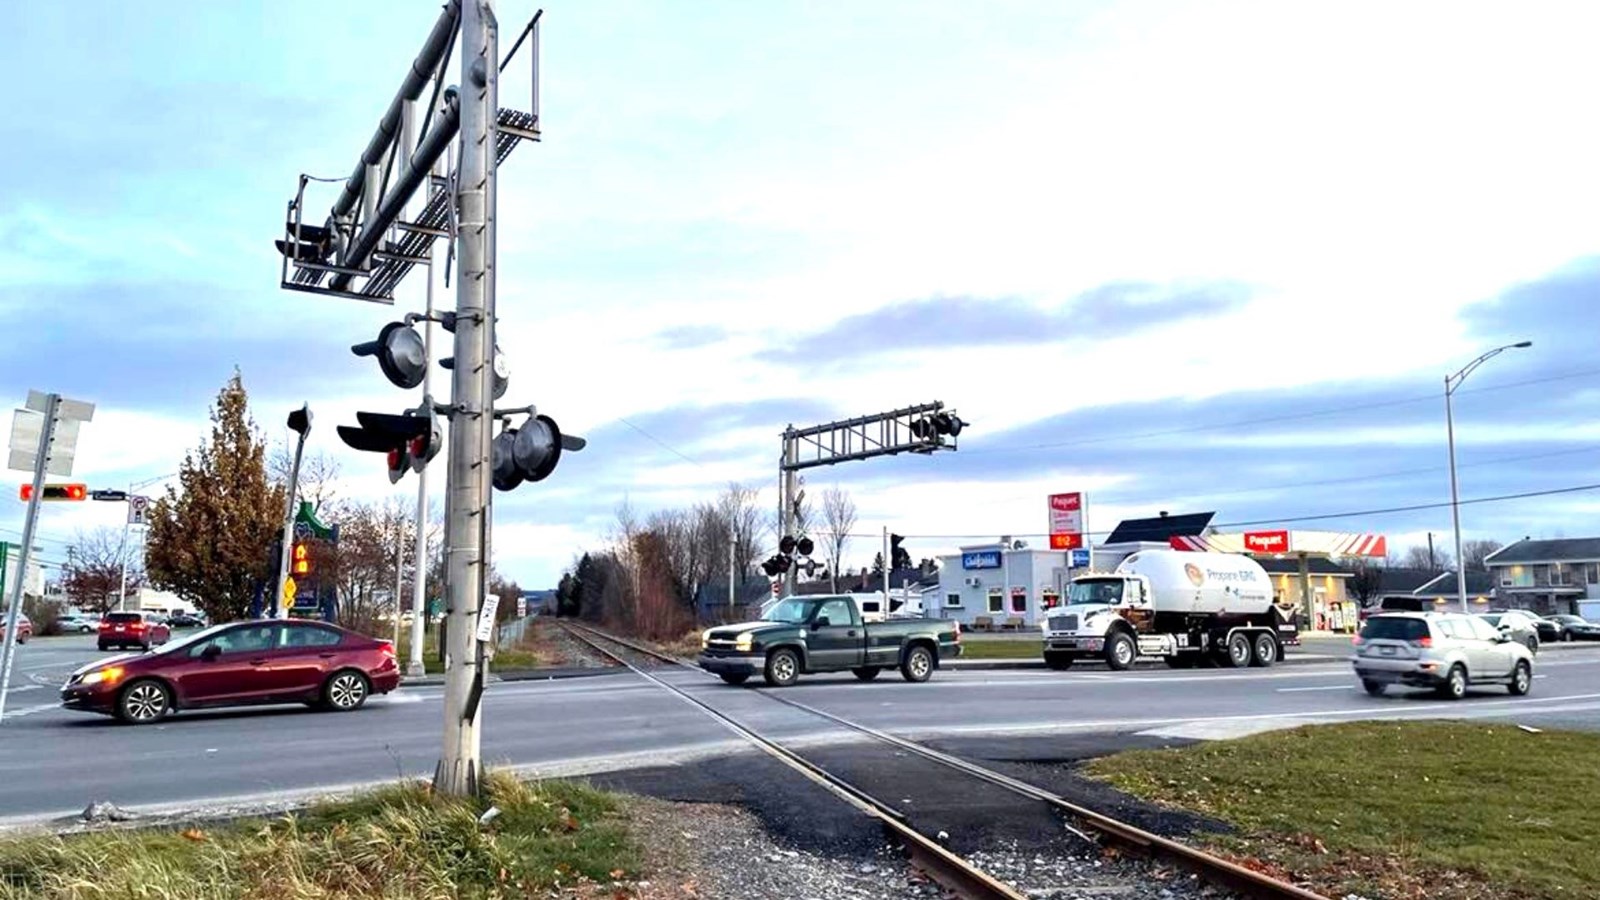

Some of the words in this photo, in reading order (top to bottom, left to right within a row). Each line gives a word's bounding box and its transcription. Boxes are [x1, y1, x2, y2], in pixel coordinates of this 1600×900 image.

[1053, 496, 1078, 508] Paquet
[1249, 535, 1282, 550] Paquet
[1206, 568, 1238, 582] Propane
